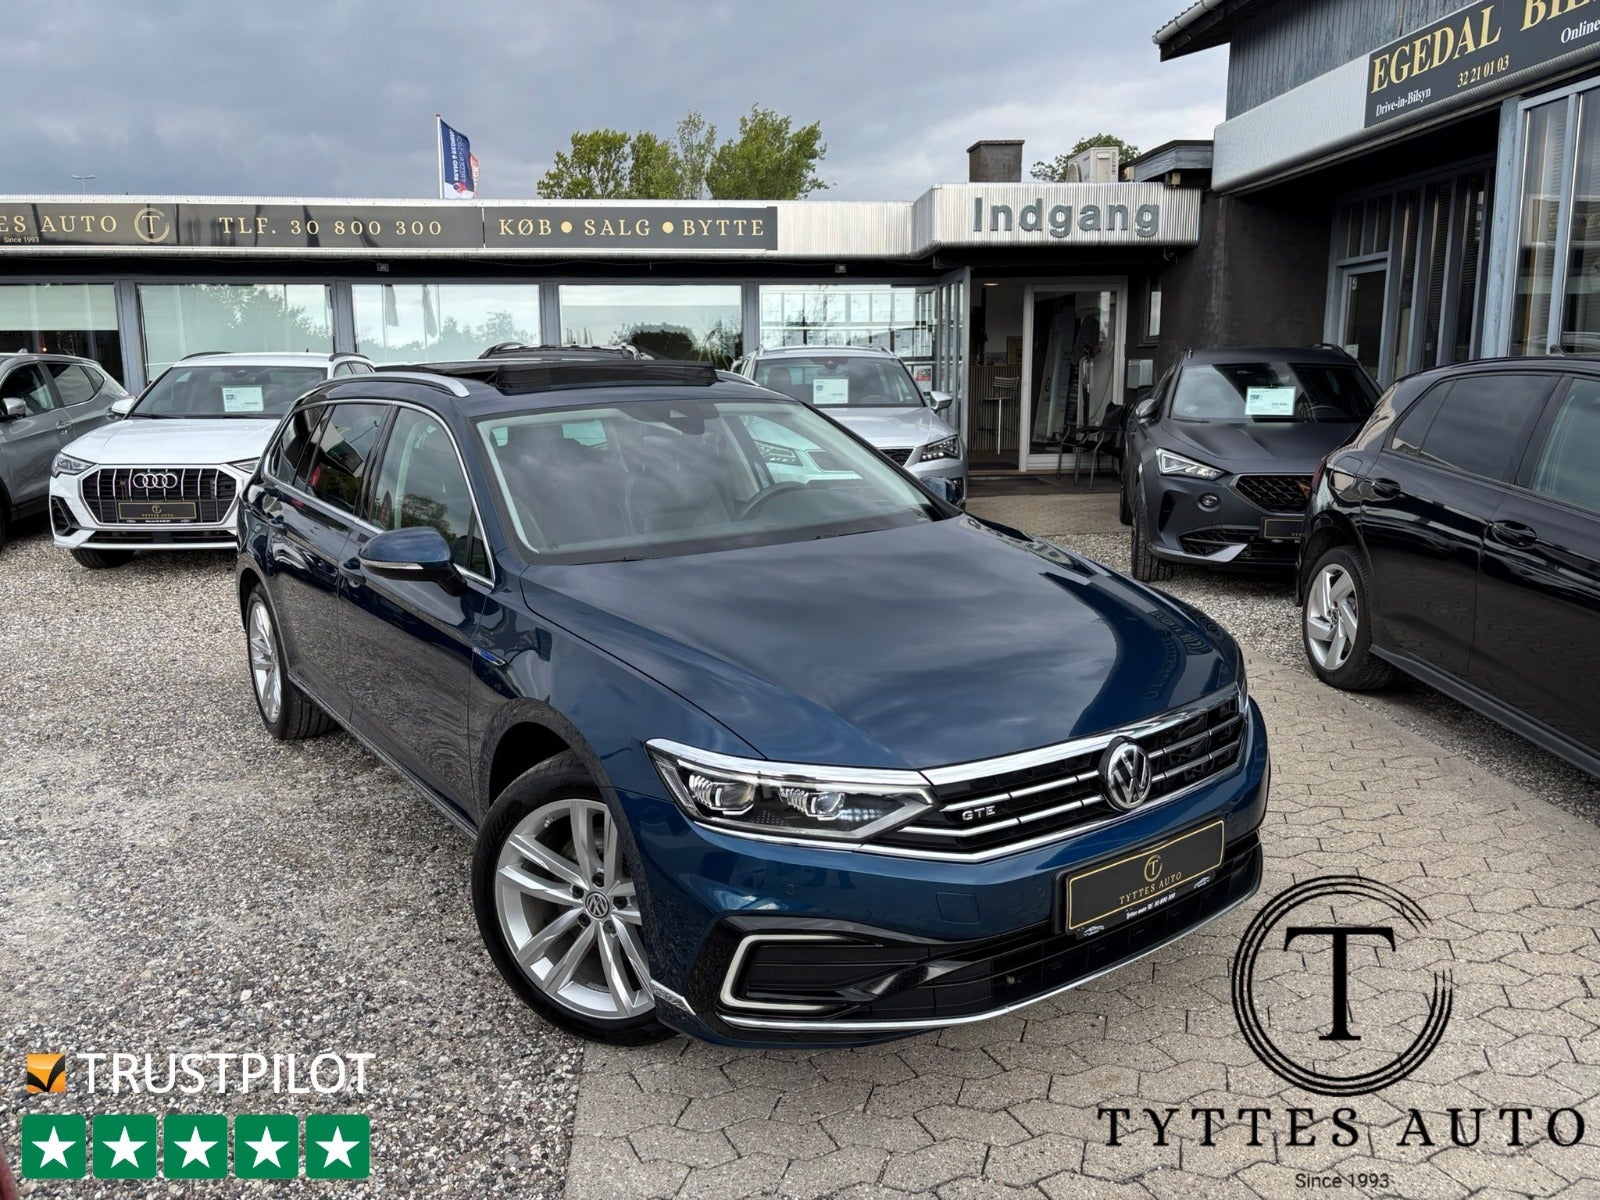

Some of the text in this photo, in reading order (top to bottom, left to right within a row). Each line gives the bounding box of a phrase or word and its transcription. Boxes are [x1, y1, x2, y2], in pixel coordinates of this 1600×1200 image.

[1561, 19, 1600, 44] Online
[1370, 4, 1502, 94] EGEDAL
[1457, 54, 1510, 88] 32 21 01 03
[1376, 87, 1432, 117] Drive-in-Bilsyn
[40, 215, 117, 233] AUTO
[218, 216, 442, 236] TLF. 30 800 300
[498, 218, 765, 236] KØB SALG BYTTE
[973, 197, 1160, 238] Indgang
[961, 804, 997, 821] GTE
[1119, 871, 1182, 905] TYTTES AUTO
